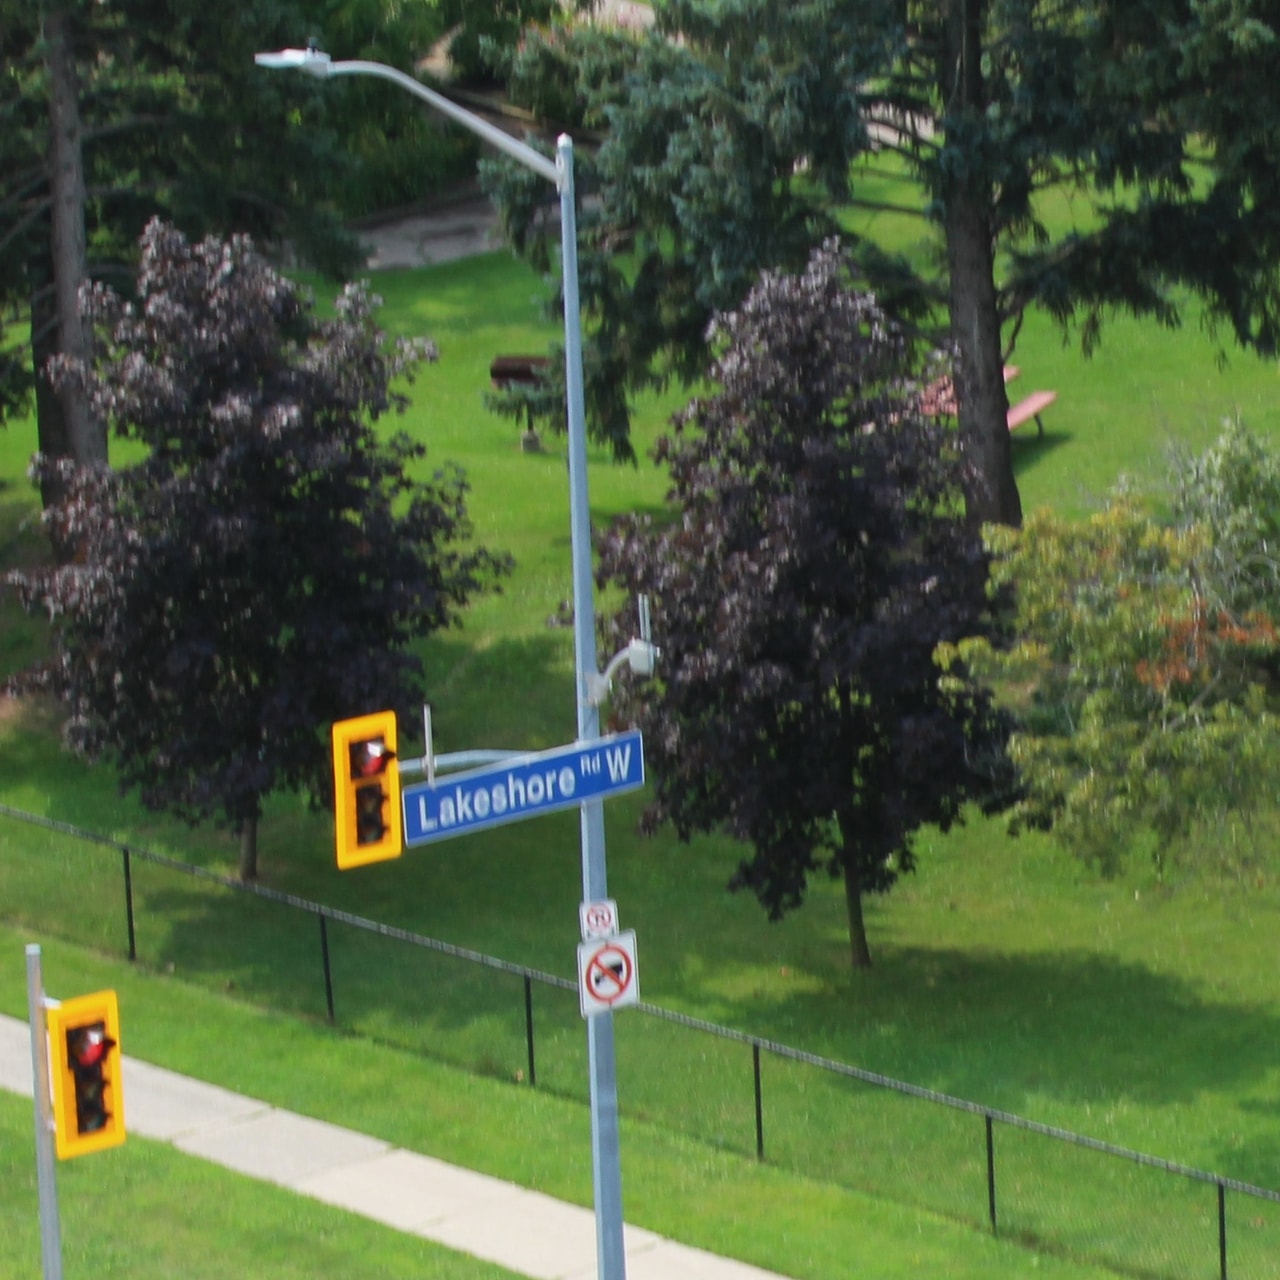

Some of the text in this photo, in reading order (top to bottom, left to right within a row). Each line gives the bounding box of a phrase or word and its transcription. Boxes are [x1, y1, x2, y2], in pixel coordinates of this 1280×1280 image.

[420, 743, 631, 831] Lakeshore Rd W
